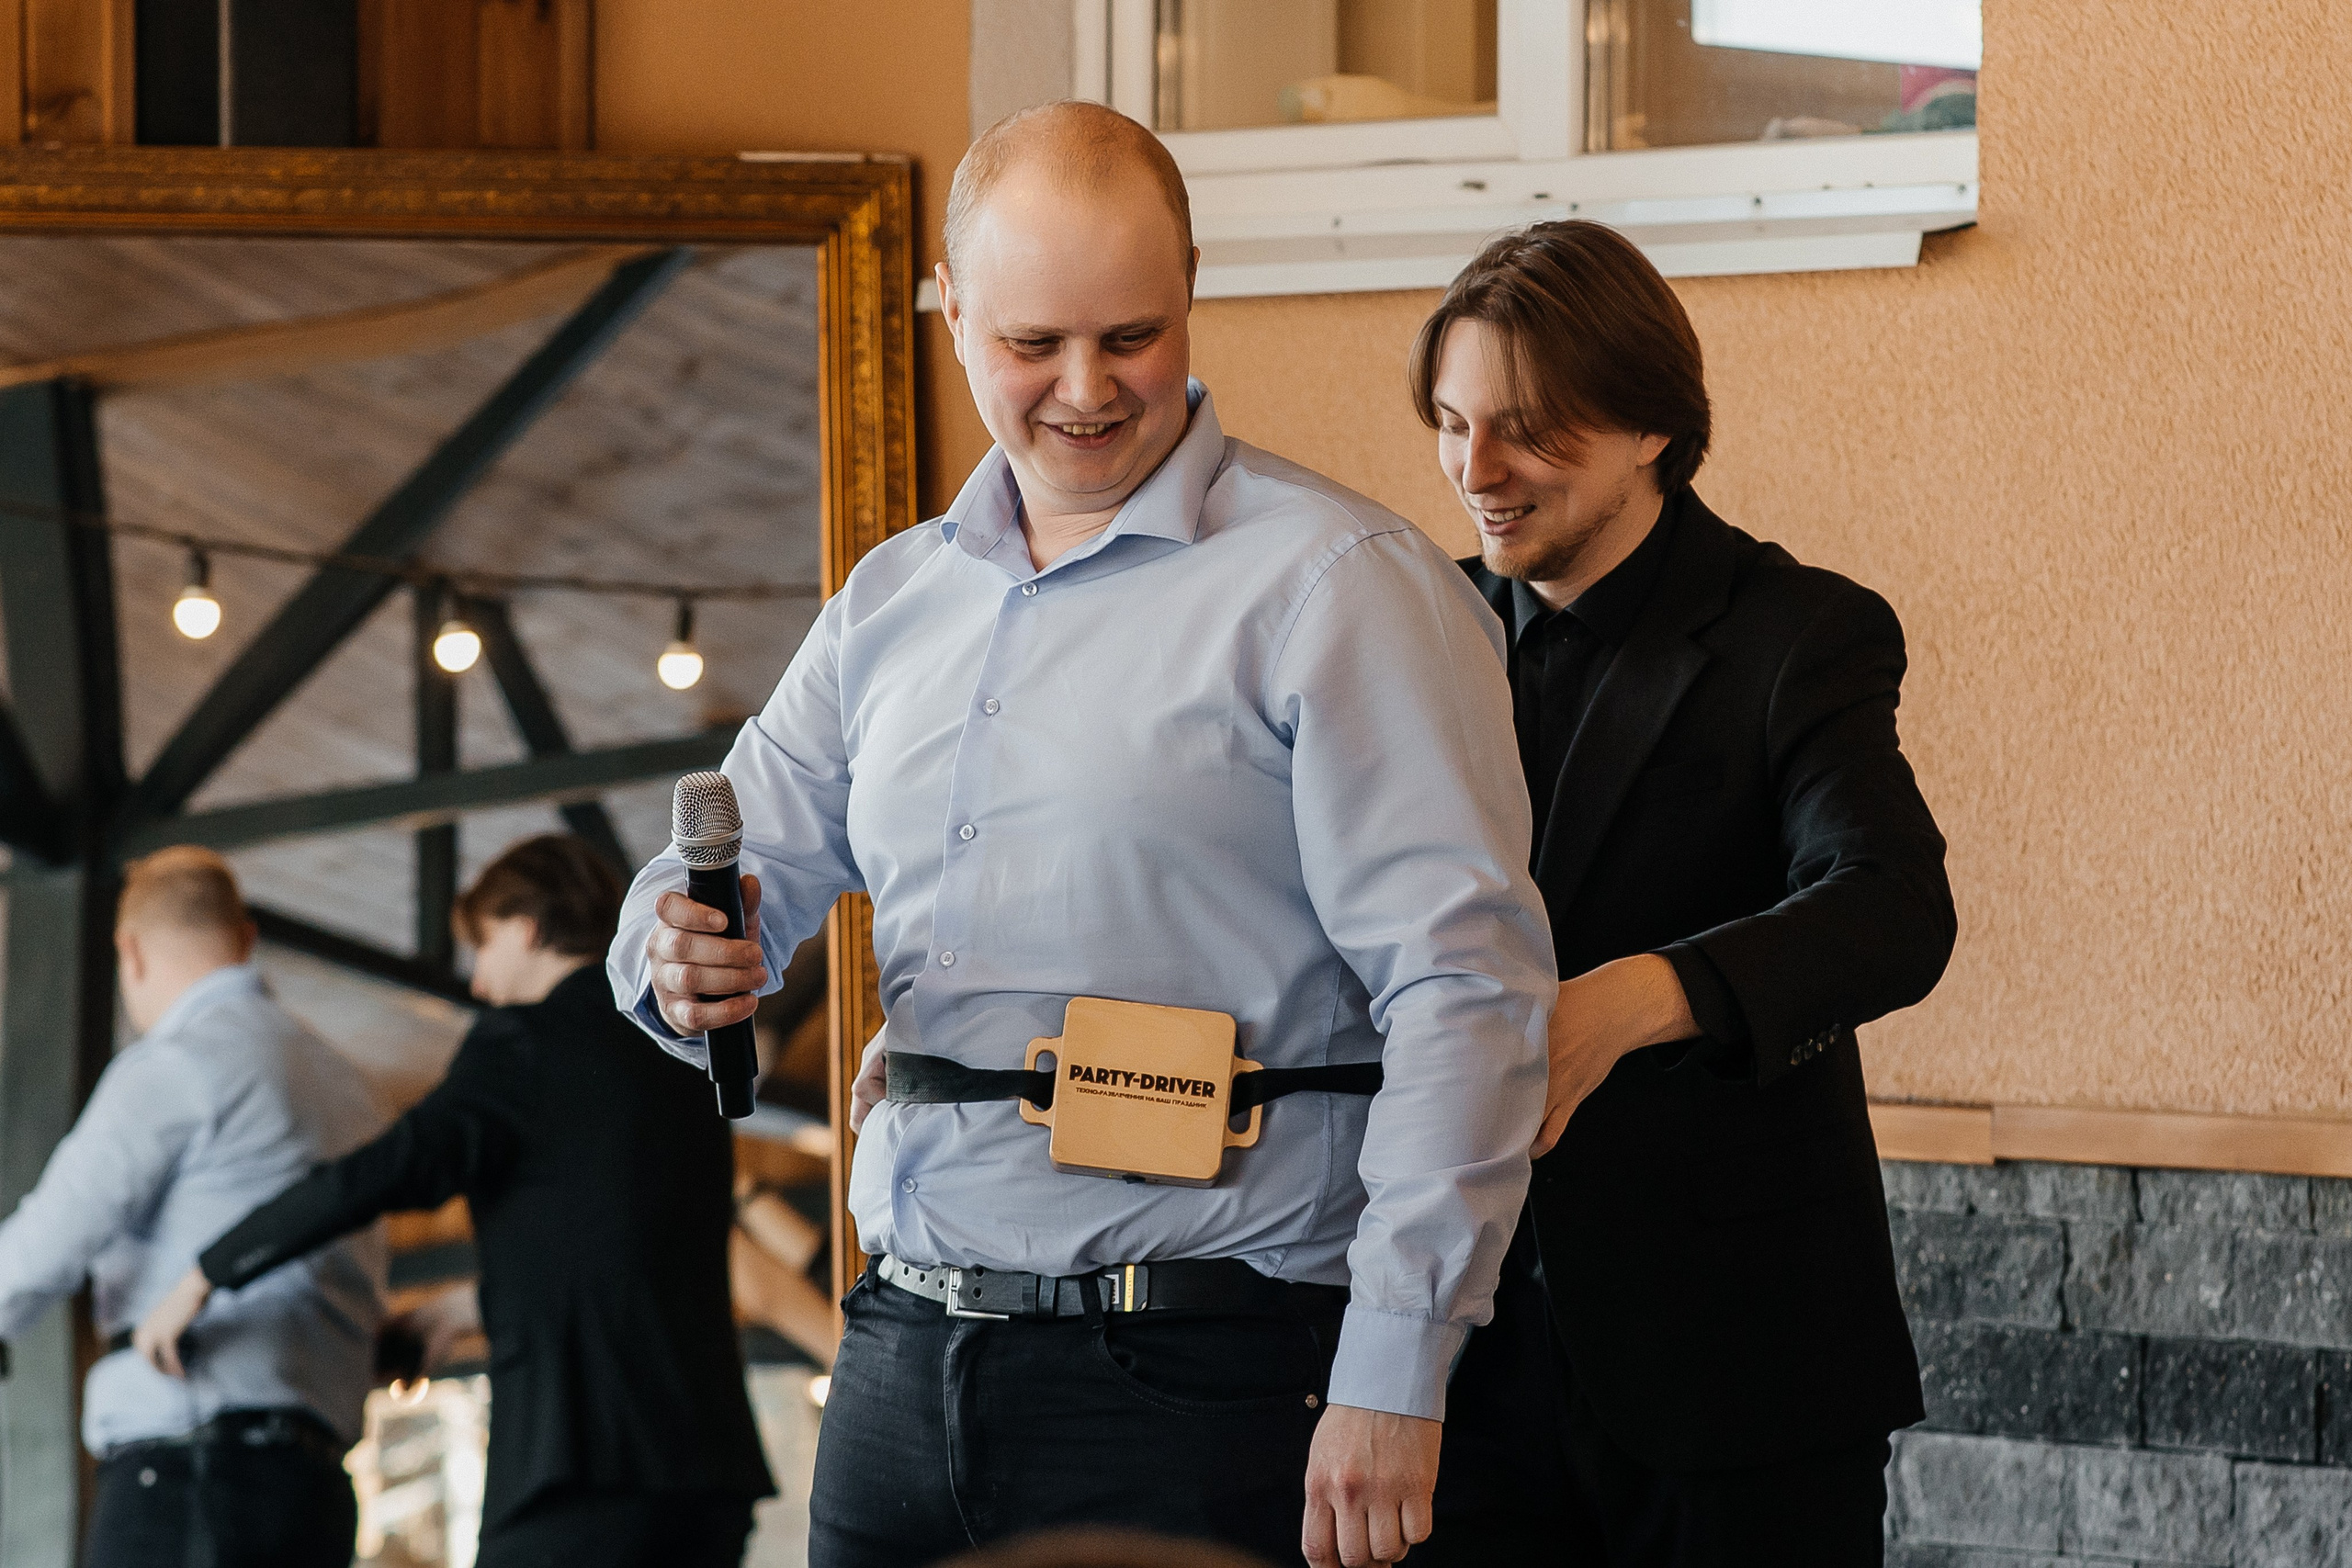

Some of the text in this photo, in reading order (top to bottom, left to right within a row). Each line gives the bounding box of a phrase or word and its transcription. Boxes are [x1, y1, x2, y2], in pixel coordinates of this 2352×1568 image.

[1069, 1065, 1216, 1098] PARTY-DRIVER
[1076, 1087, 1144, 1100] ТЕХНО-РАЗВЛЕЧЕНИЯ
[1172, 1100, 1207, 1109] ПРАЗДНИК
